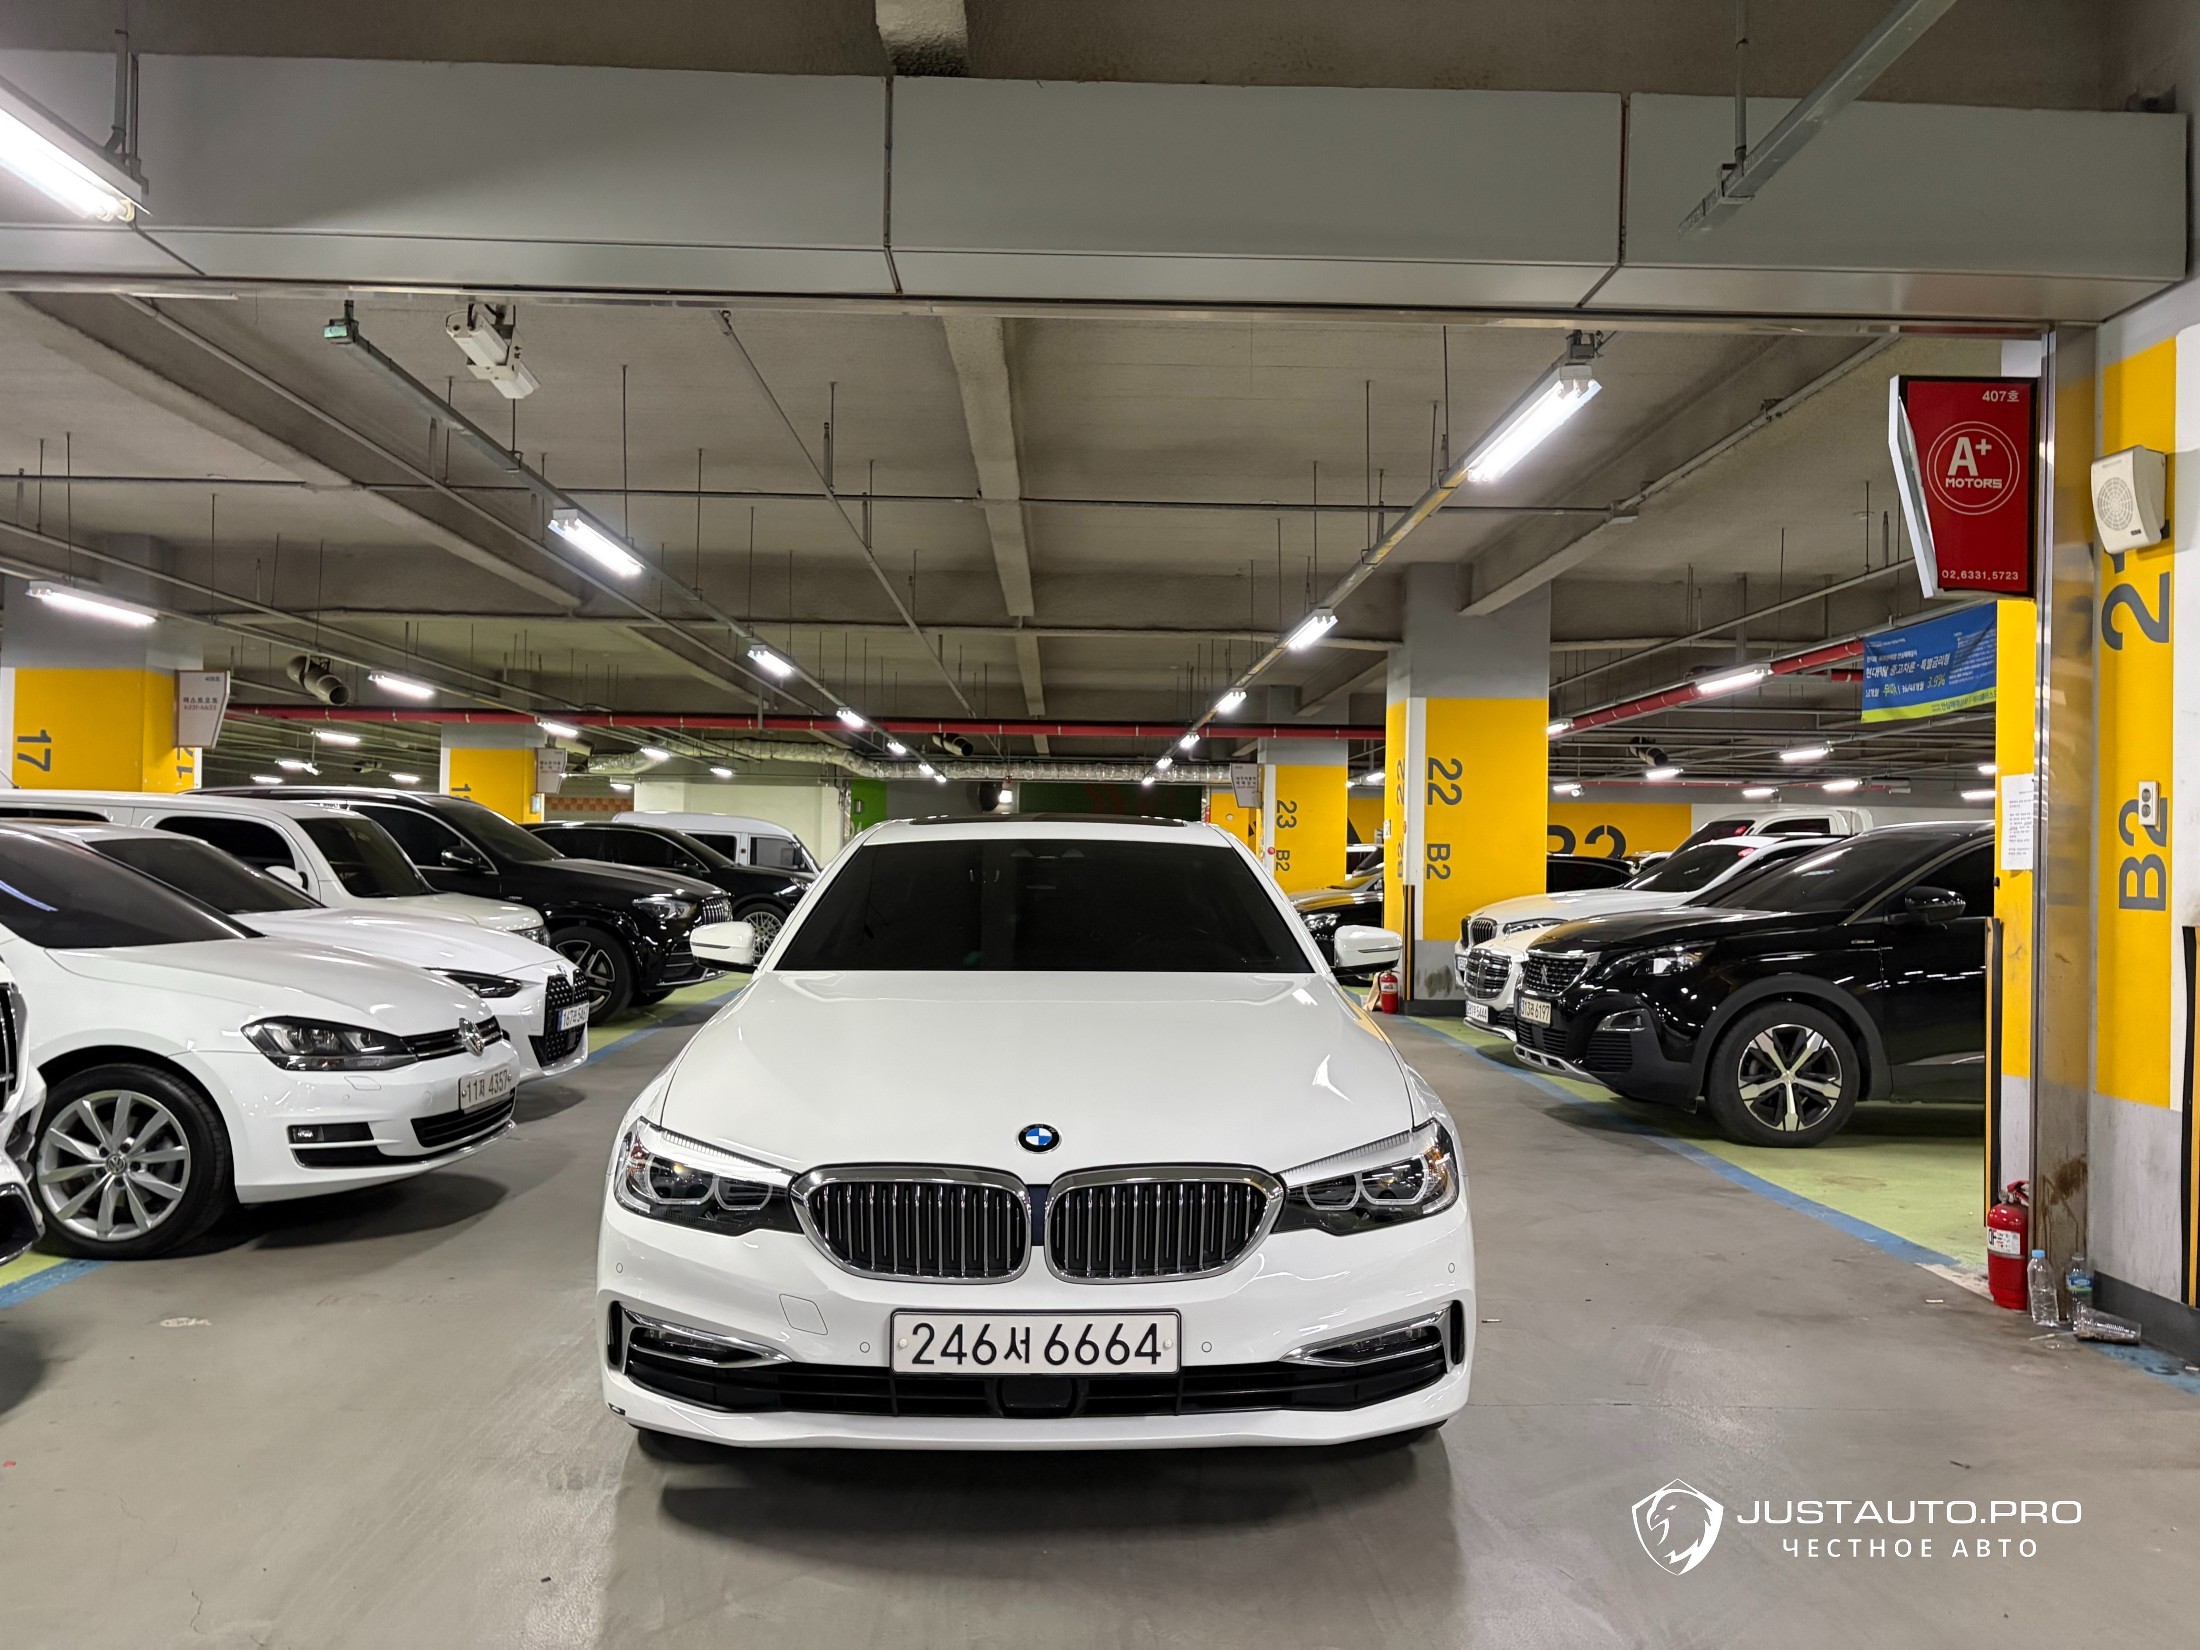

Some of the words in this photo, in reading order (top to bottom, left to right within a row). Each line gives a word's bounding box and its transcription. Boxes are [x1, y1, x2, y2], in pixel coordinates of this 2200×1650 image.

[1982, 390, 2020, 403] 407호
[1947, 436, 1993, 477] A+
[1945, 478, 2003, 490] MOTORS
[1941, 569, 2019, 581] 02.6331.5723
[17, 729, 52, 772] 17
[1428, 757, 1463, 806] 22
[1276, 800, 1298, 829] 23
[1276, 849, 1290, 872] B2
[1427, 843, 1451, 880] B2
[2118, 797, 2168, 912] B2
